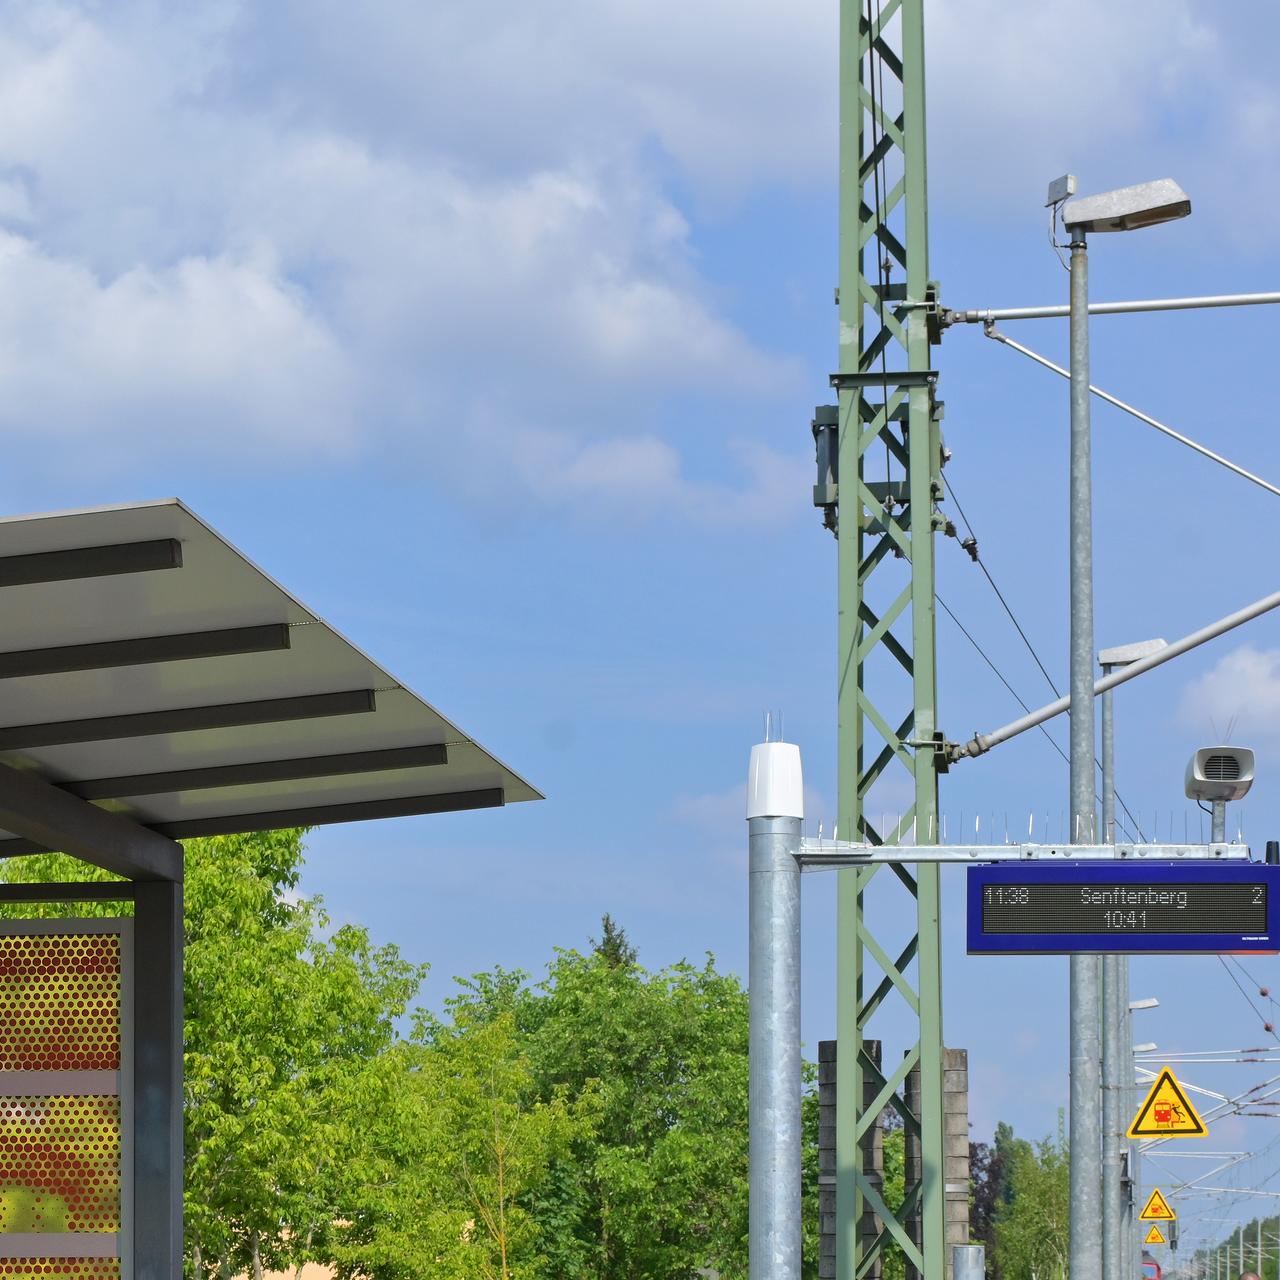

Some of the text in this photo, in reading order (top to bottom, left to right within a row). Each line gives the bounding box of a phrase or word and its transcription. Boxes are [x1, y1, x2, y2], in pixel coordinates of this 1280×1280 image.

[984, 887, 1263, 909] 11:38 Senftenberg 2
[1103, 910, 1146, 928] 10:41
